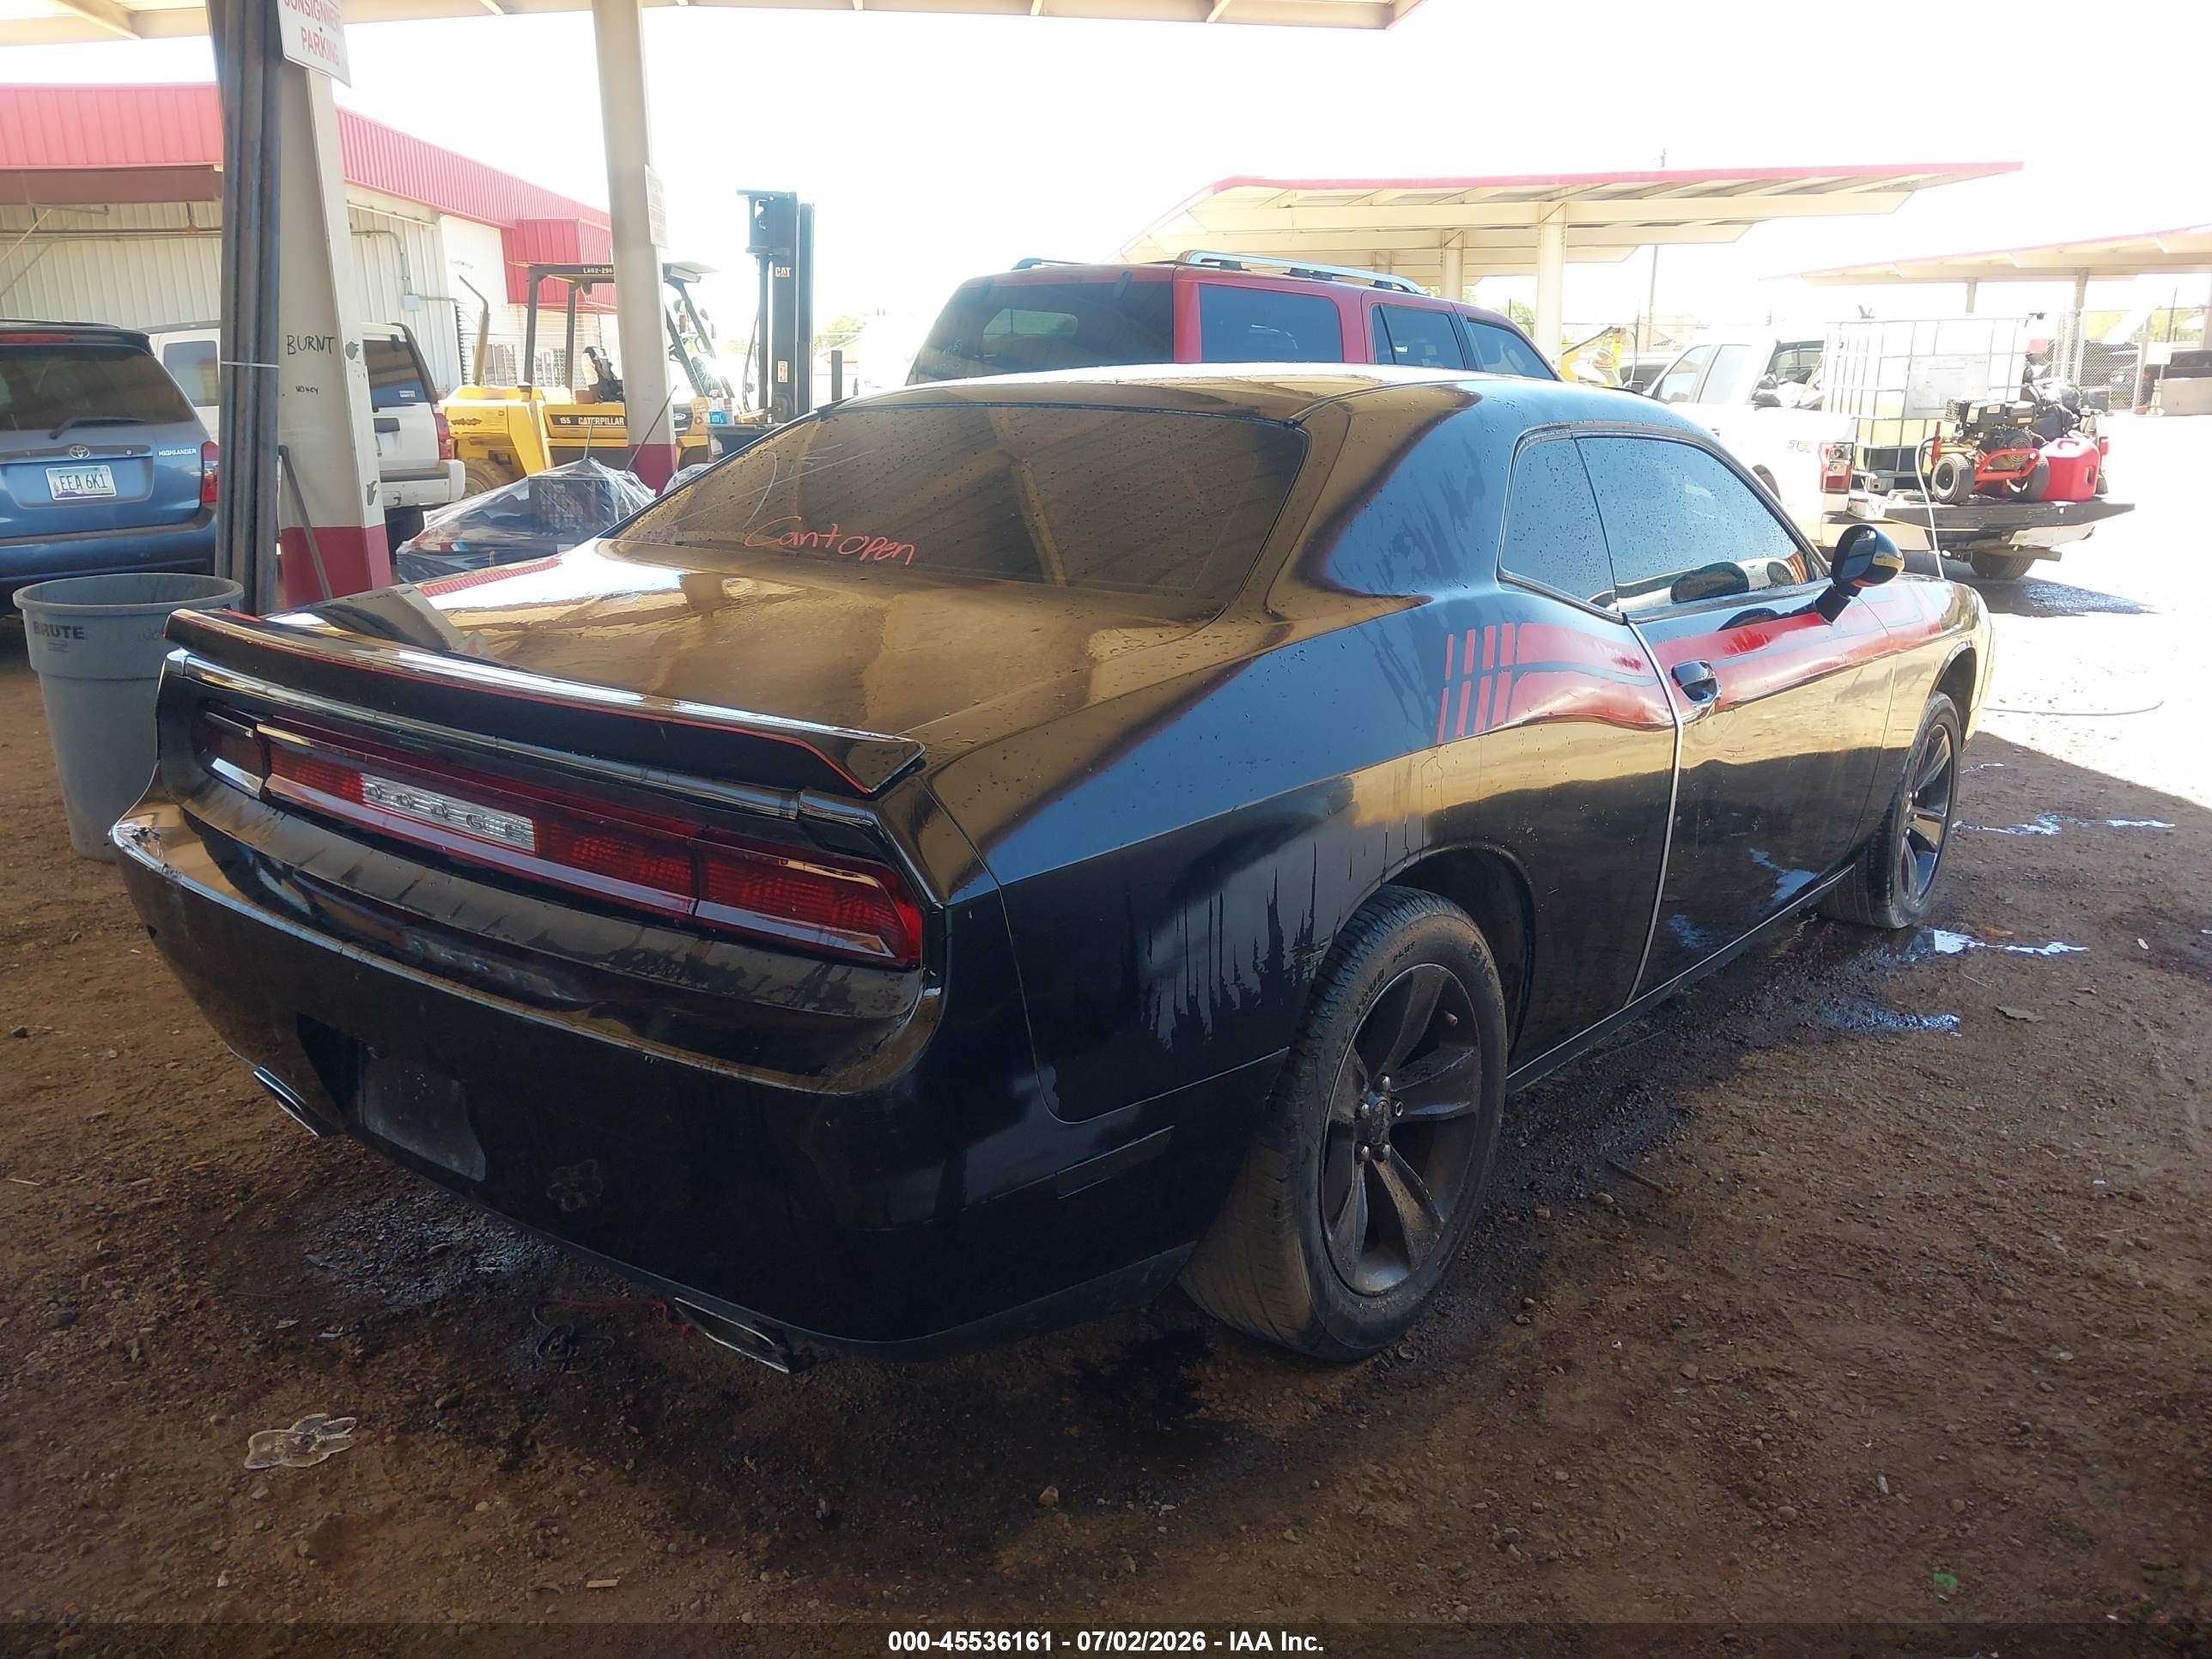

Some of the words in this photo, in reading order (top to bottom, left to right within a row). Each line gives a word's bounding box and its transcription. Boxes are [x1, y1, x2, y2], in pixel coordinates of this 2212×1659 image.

[775, 266, 791, 277] CAT
[287, 334, 335, 356] BURNT
[578, 416, 625, 426] CATERPILLAR
[58, 474, 83, 491] EEA
[86, 473, 108, 489] 6K1
[33, 621, 85, 640] BRUTE
